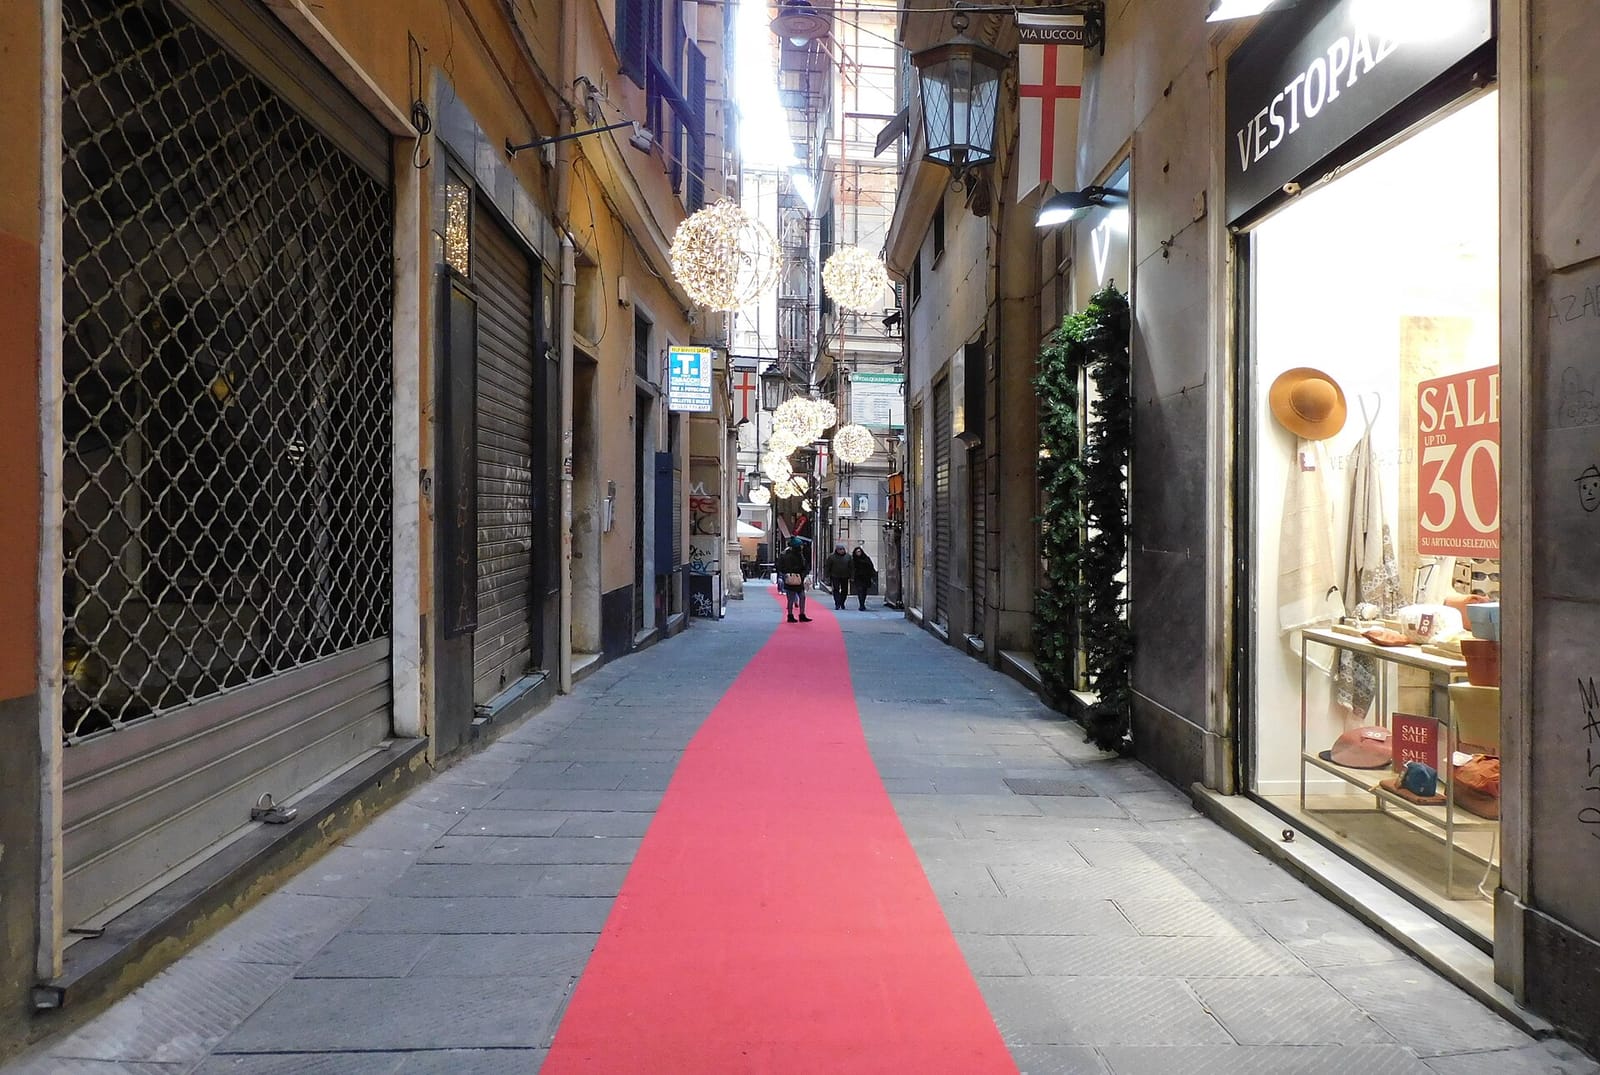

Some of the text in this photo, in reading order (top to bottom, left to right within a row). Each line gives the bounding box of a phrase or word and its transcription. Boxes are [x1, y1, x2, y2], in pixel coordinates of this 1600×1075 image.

[1019, 29, 1083, 40] VIA LUCCOLI
[1424, 433, 1447, 446] UP TO
[1420, 439, 1499, 533] 30
[1422, 537, 1499, 549] SU ARTICOLI SELEZION
[1402, 725, 1428, 735] SALE
[1402, 733, 1428, 744] SALE
[1402, 748, 1428, 760] SALE
